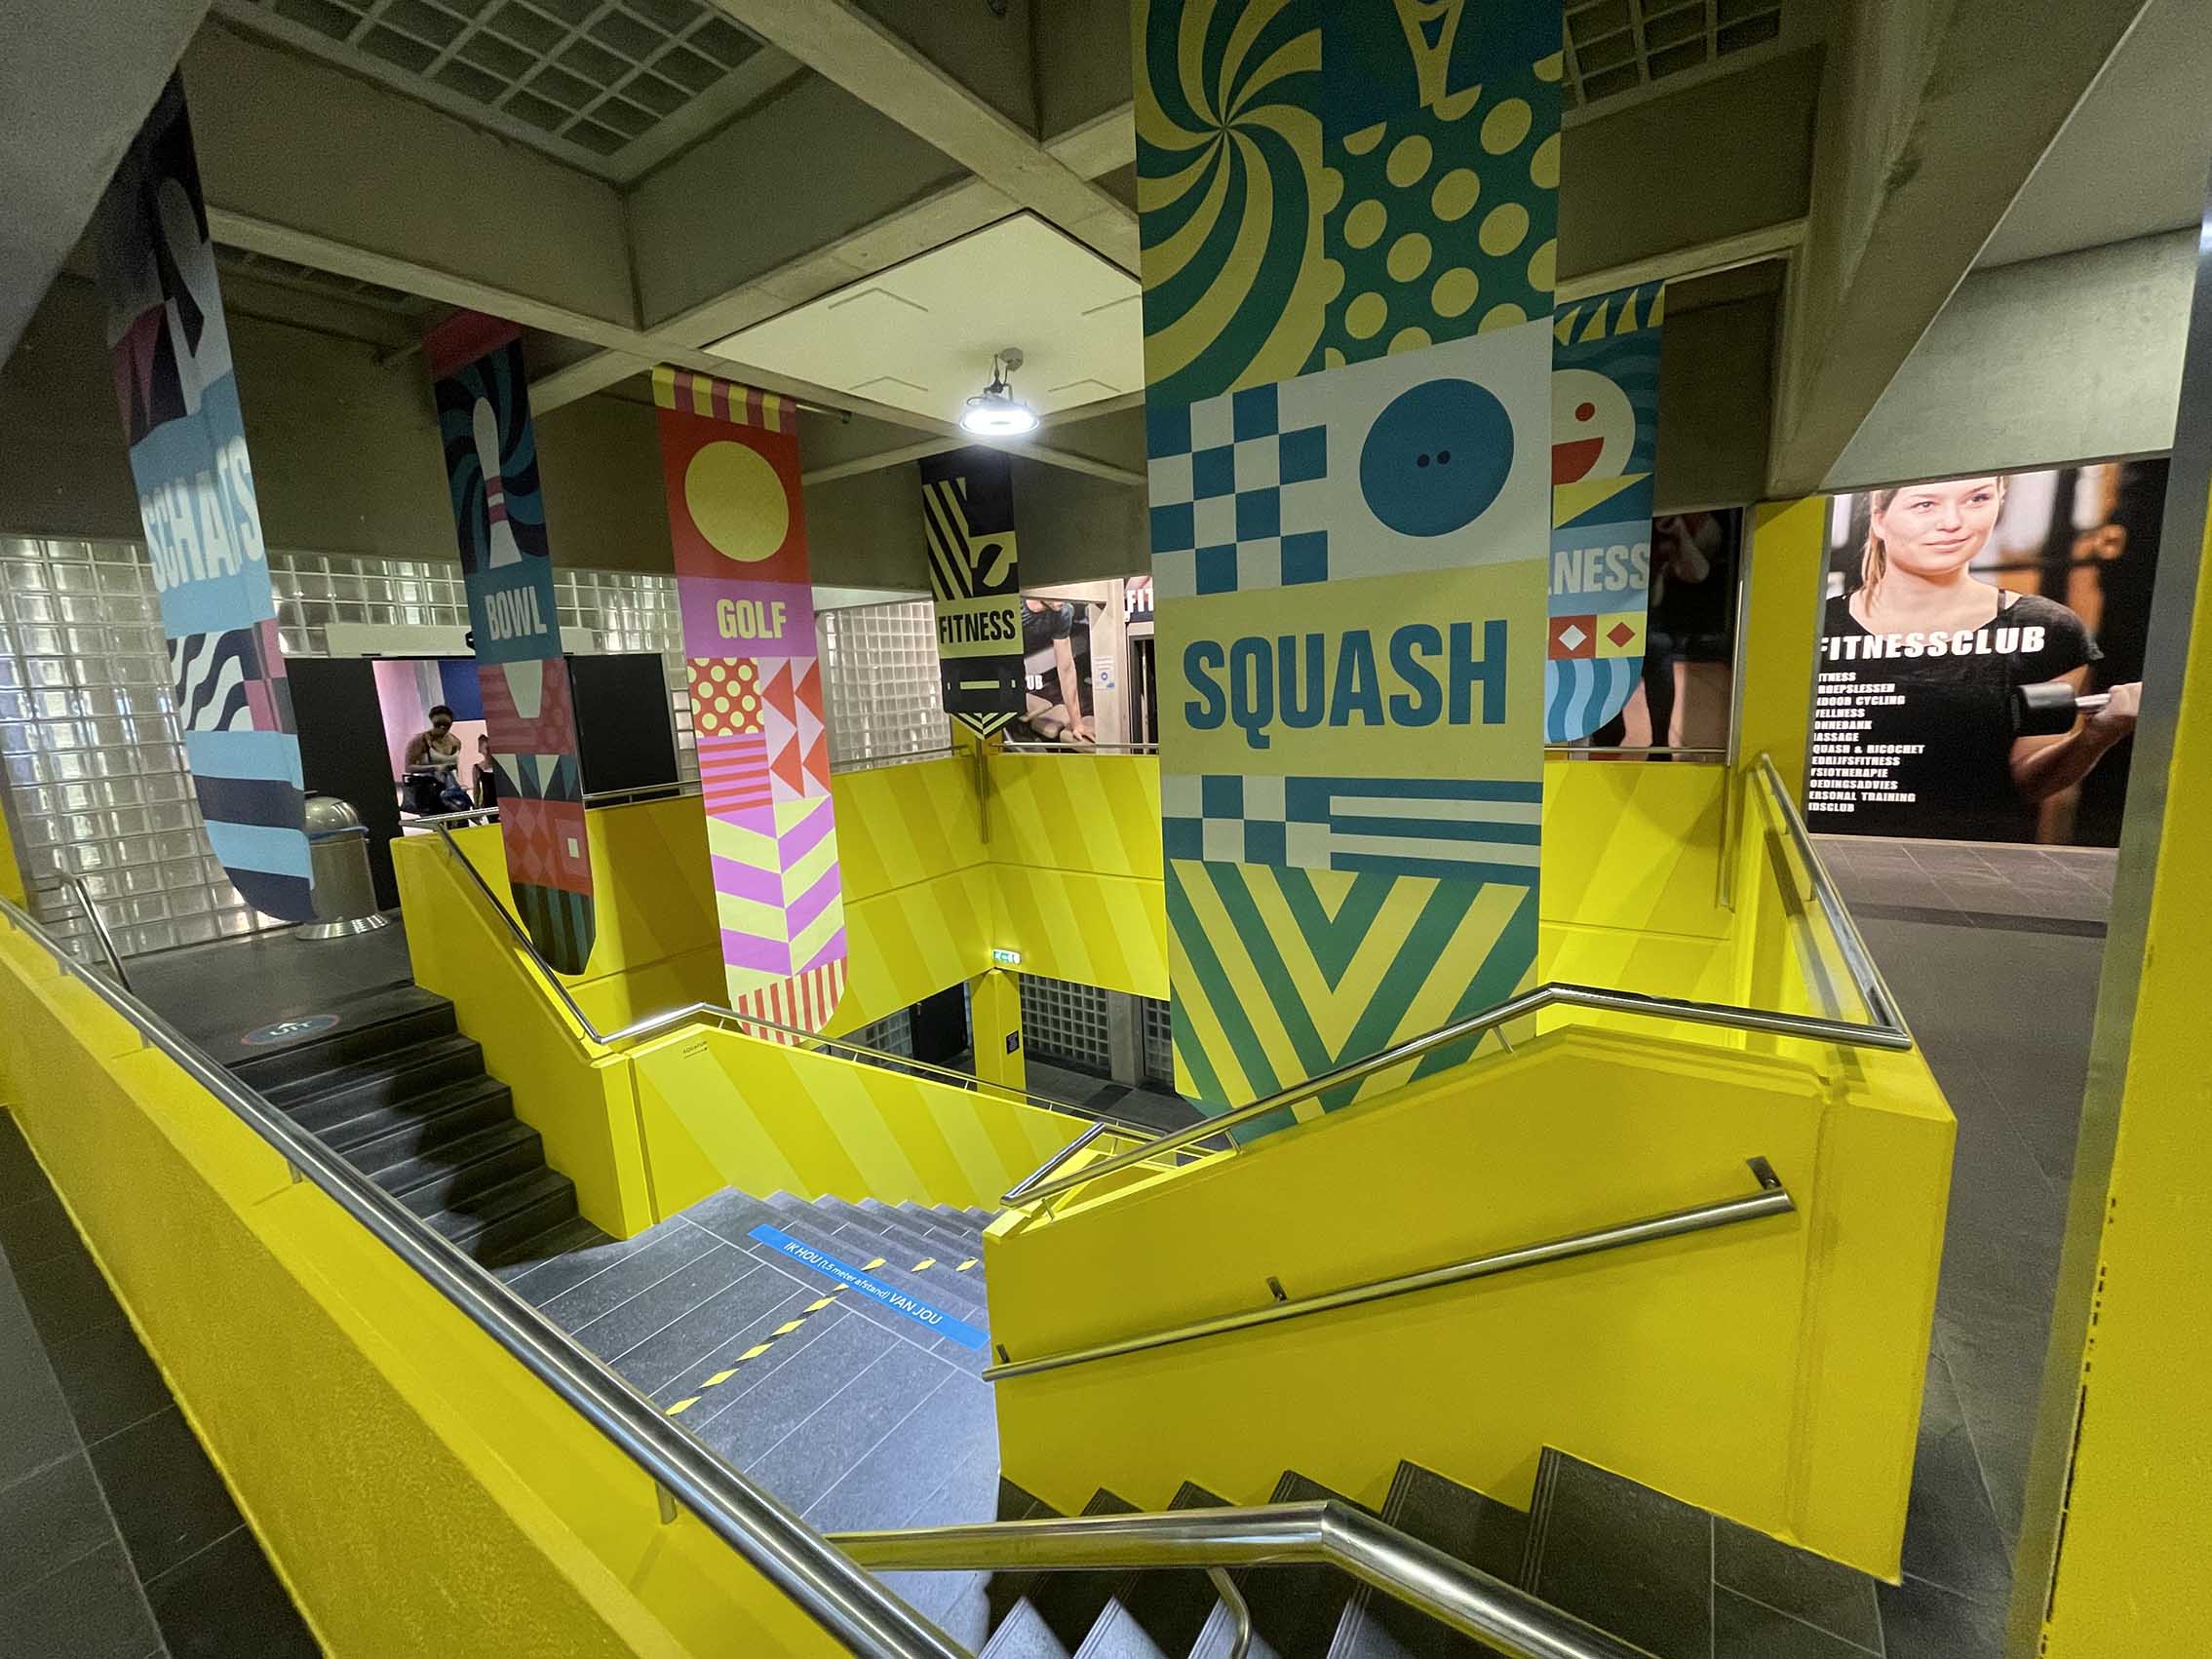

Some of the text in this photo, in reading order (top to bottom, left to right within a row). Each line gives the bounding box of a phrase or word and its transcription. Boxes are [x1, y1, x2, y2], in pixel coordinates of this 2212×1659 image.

[1548, 542, 1649, 596] NESS
[485, 586, 547, 640] BOWL
[717, 598, 786, 638] GOLF
[939, 609, 1015, 644] FITNESS
[1184, 619, 1507, 750] SQUASH
[1855, 696, 1906, 706] CYCLING
[1813, 732, 1859, 742] ASSAGE
[1853, 746, 1863, 754] &
[1866, 745, 1925, 754] RICOCHET
[1861, 792, 1916, 802] TRAINING
[783, 1241, 799, 1253] IK
[794, 1247, 823, 1264] HOU
[832, 1268, 857, 1283] meter
[854, 1279, 890, 1300] afstand)
[888, 1292, 917, 1312] VAN
[912, 1307, 944, 1325] JOU
